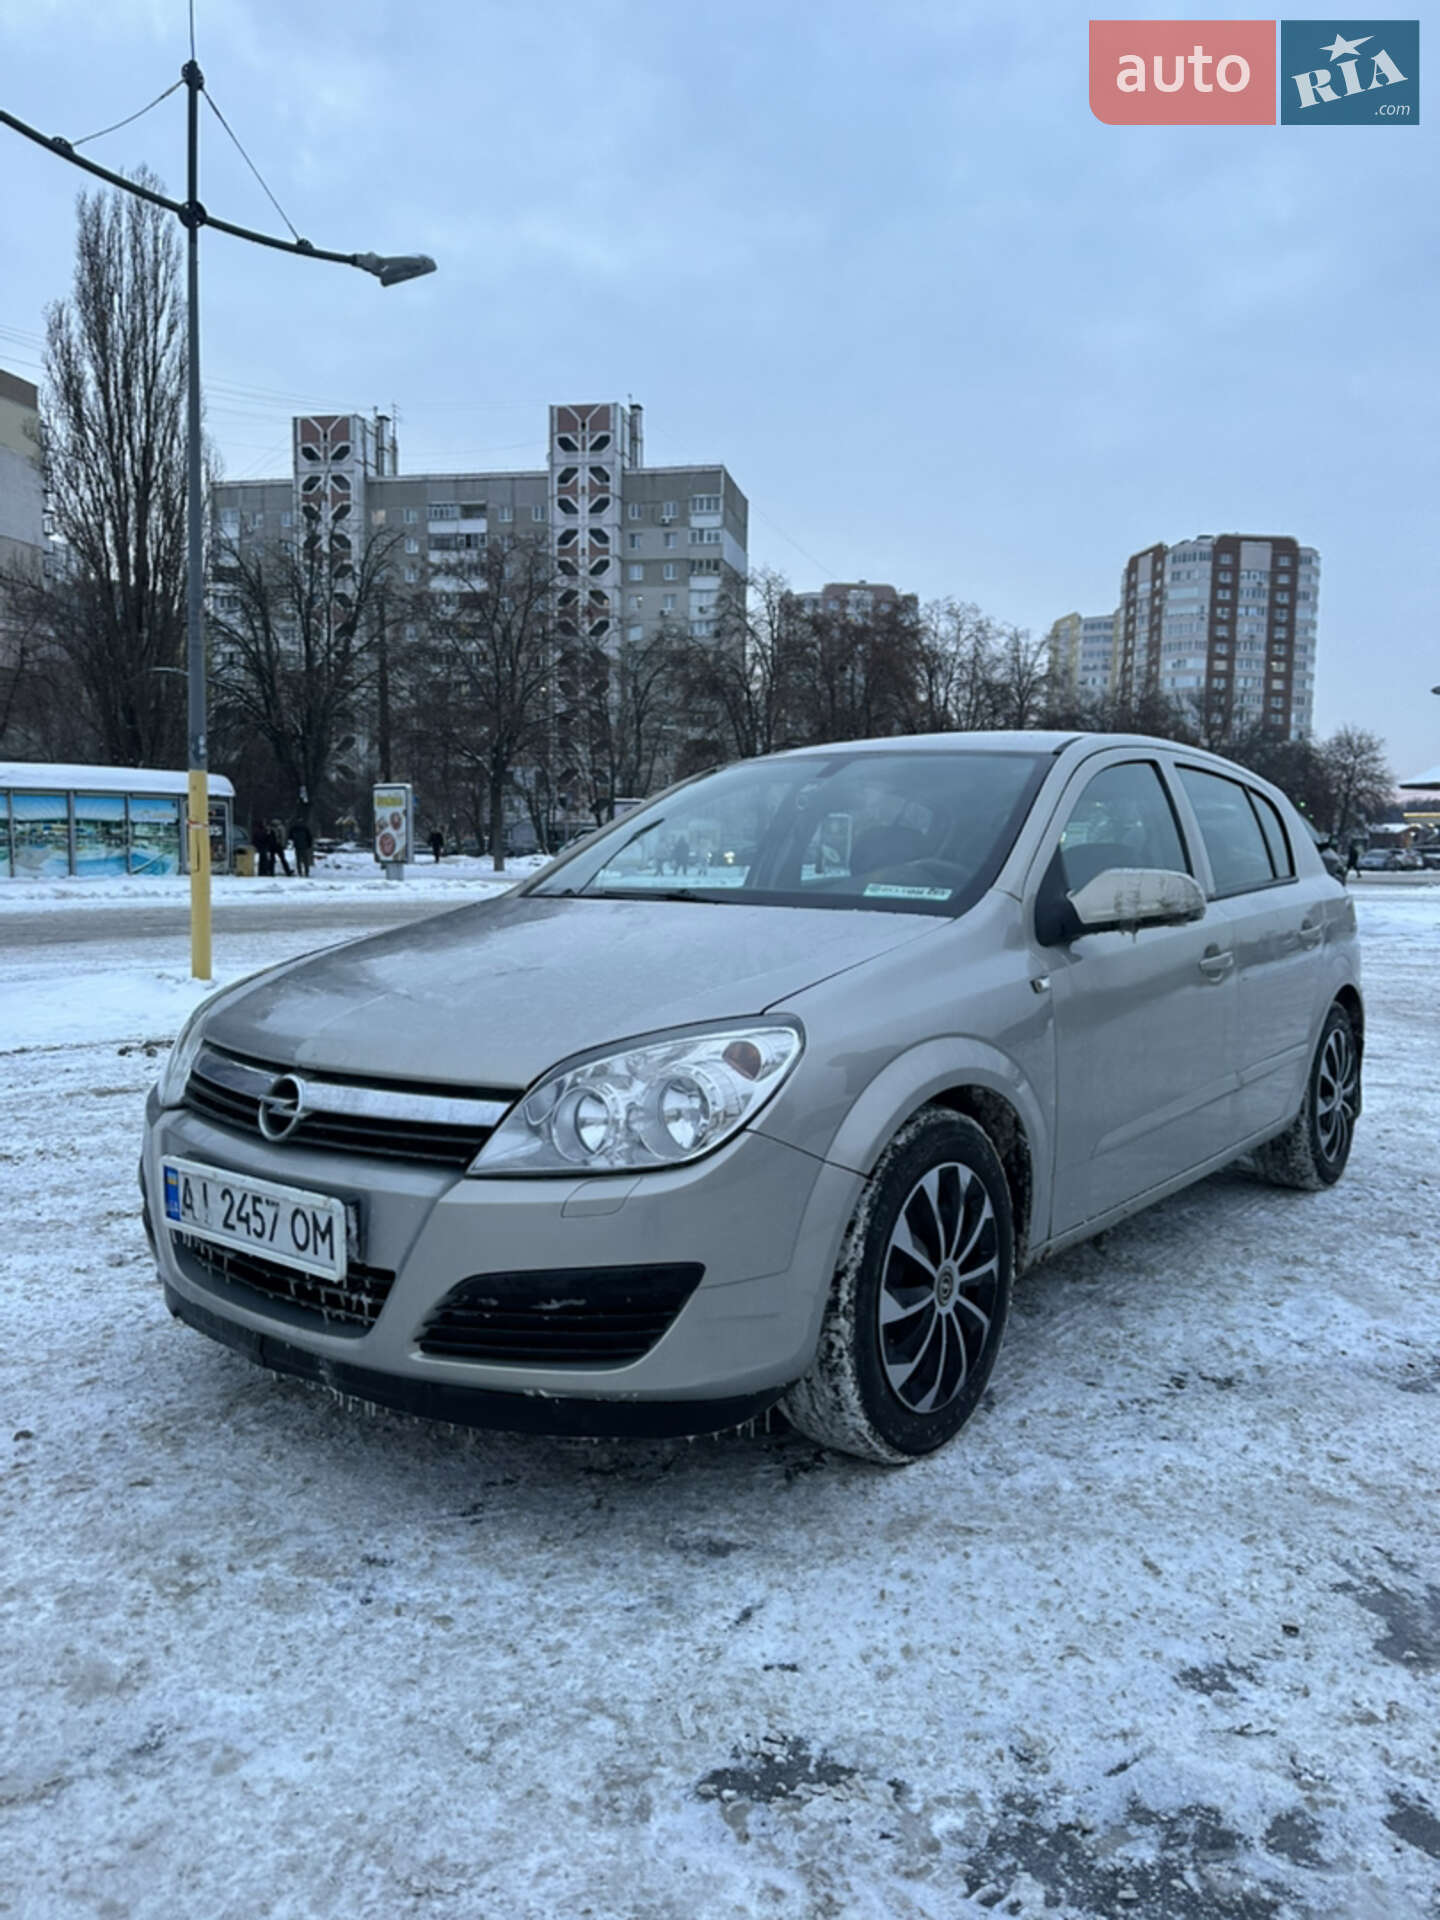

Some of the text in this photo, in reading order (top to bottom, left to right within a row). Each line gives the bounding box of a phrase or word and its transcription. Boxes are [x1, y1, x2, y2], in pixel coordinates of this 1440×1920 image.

[180, 1177, 335, 1261] AI 2457 OM
